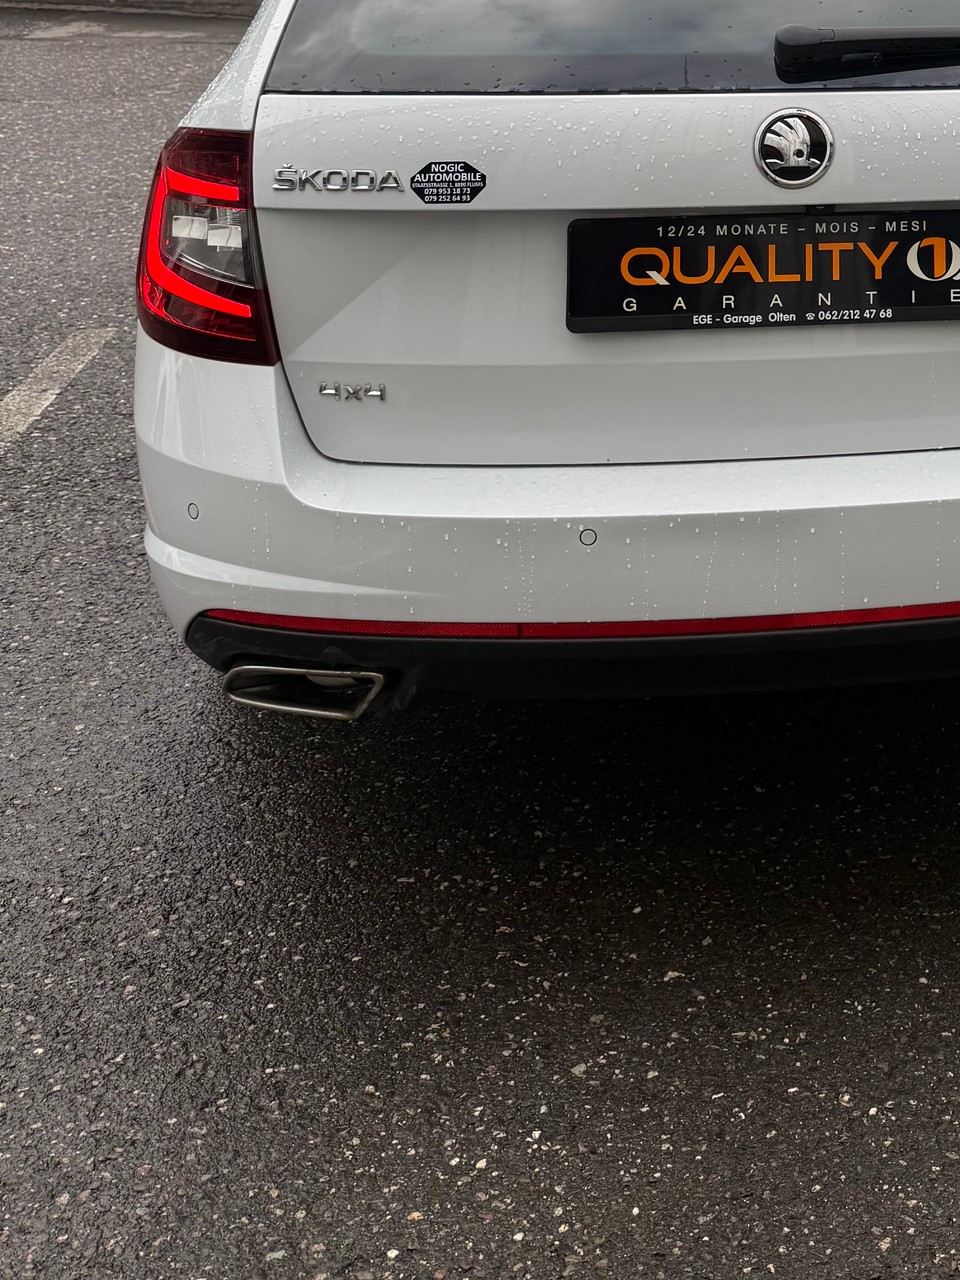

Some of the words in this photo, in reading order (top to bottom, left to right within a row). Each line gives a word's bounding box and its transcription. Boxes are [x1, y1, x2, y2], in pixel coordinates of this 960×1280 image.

[431, 163, 465, 172] NOGIC
[272, 163, 405, 192] ŠKODA
[413, 172, 482, 182] AUTOMOBILE
[657, 225, 706, 237] 12/24
[716, 223, 788, 236] MONATE
[815, 222, 859, 233] MOIS
[885, 220, 927, 232] MESI
[620, 240, 899, 286] QUALITY
[693, 314, 713, 325] EGE
[723, 313, 763, 325] Garage
[768, 312, 796, 322] Olten
[818, 309, 860, 321] 062/212
[863, 309, 877, 319] 47
[879, 308, 893, 319] 68
